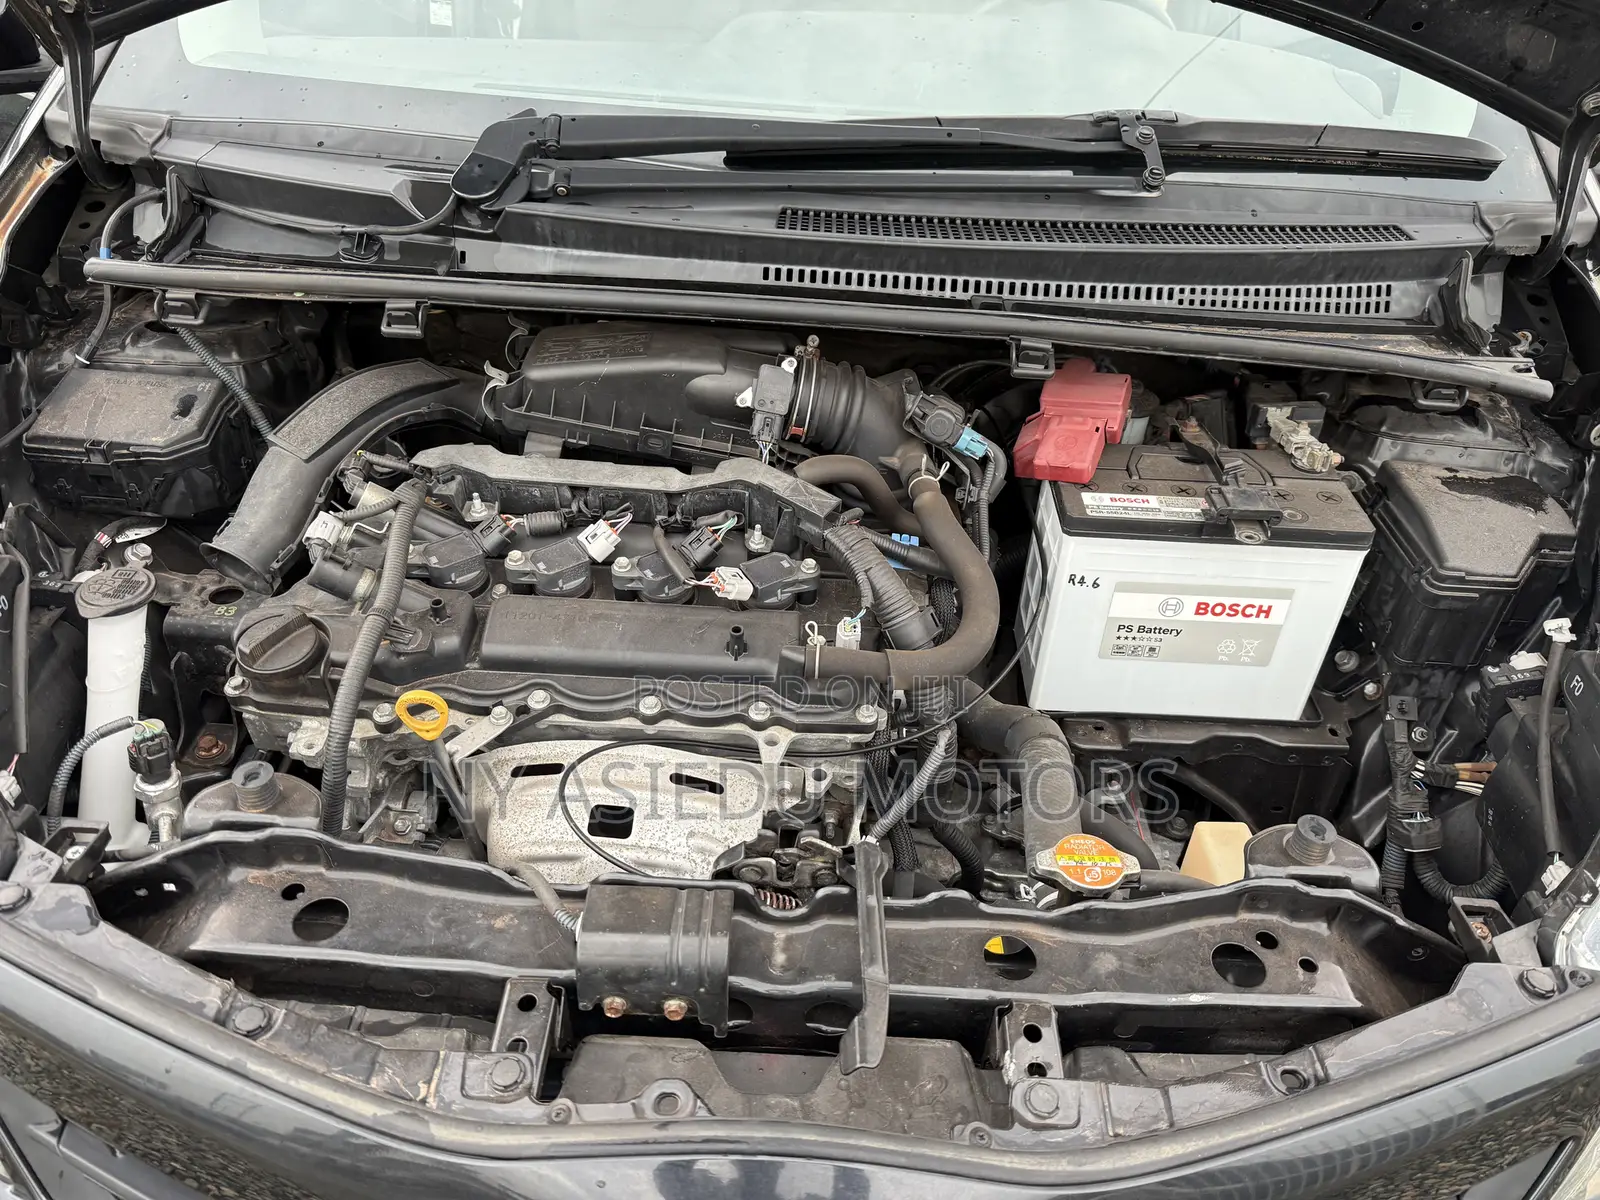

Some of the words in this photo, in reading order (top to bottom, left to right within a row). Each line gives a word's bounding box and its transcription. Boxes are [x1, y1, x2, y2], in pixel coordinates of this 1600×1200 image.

[1109, 496, 1150, 505] BOSCH
[1068, 573, 1101, 589] R4.6
[1193, 601, 1273, 619] BOSCH
[1116, 624, 1135, 634] PS
[1136, 624, 1184, 638] Battery
[1063, 843, 1105, 851] RADIATOR
[1073, 848, 1099, 856] VALVE
